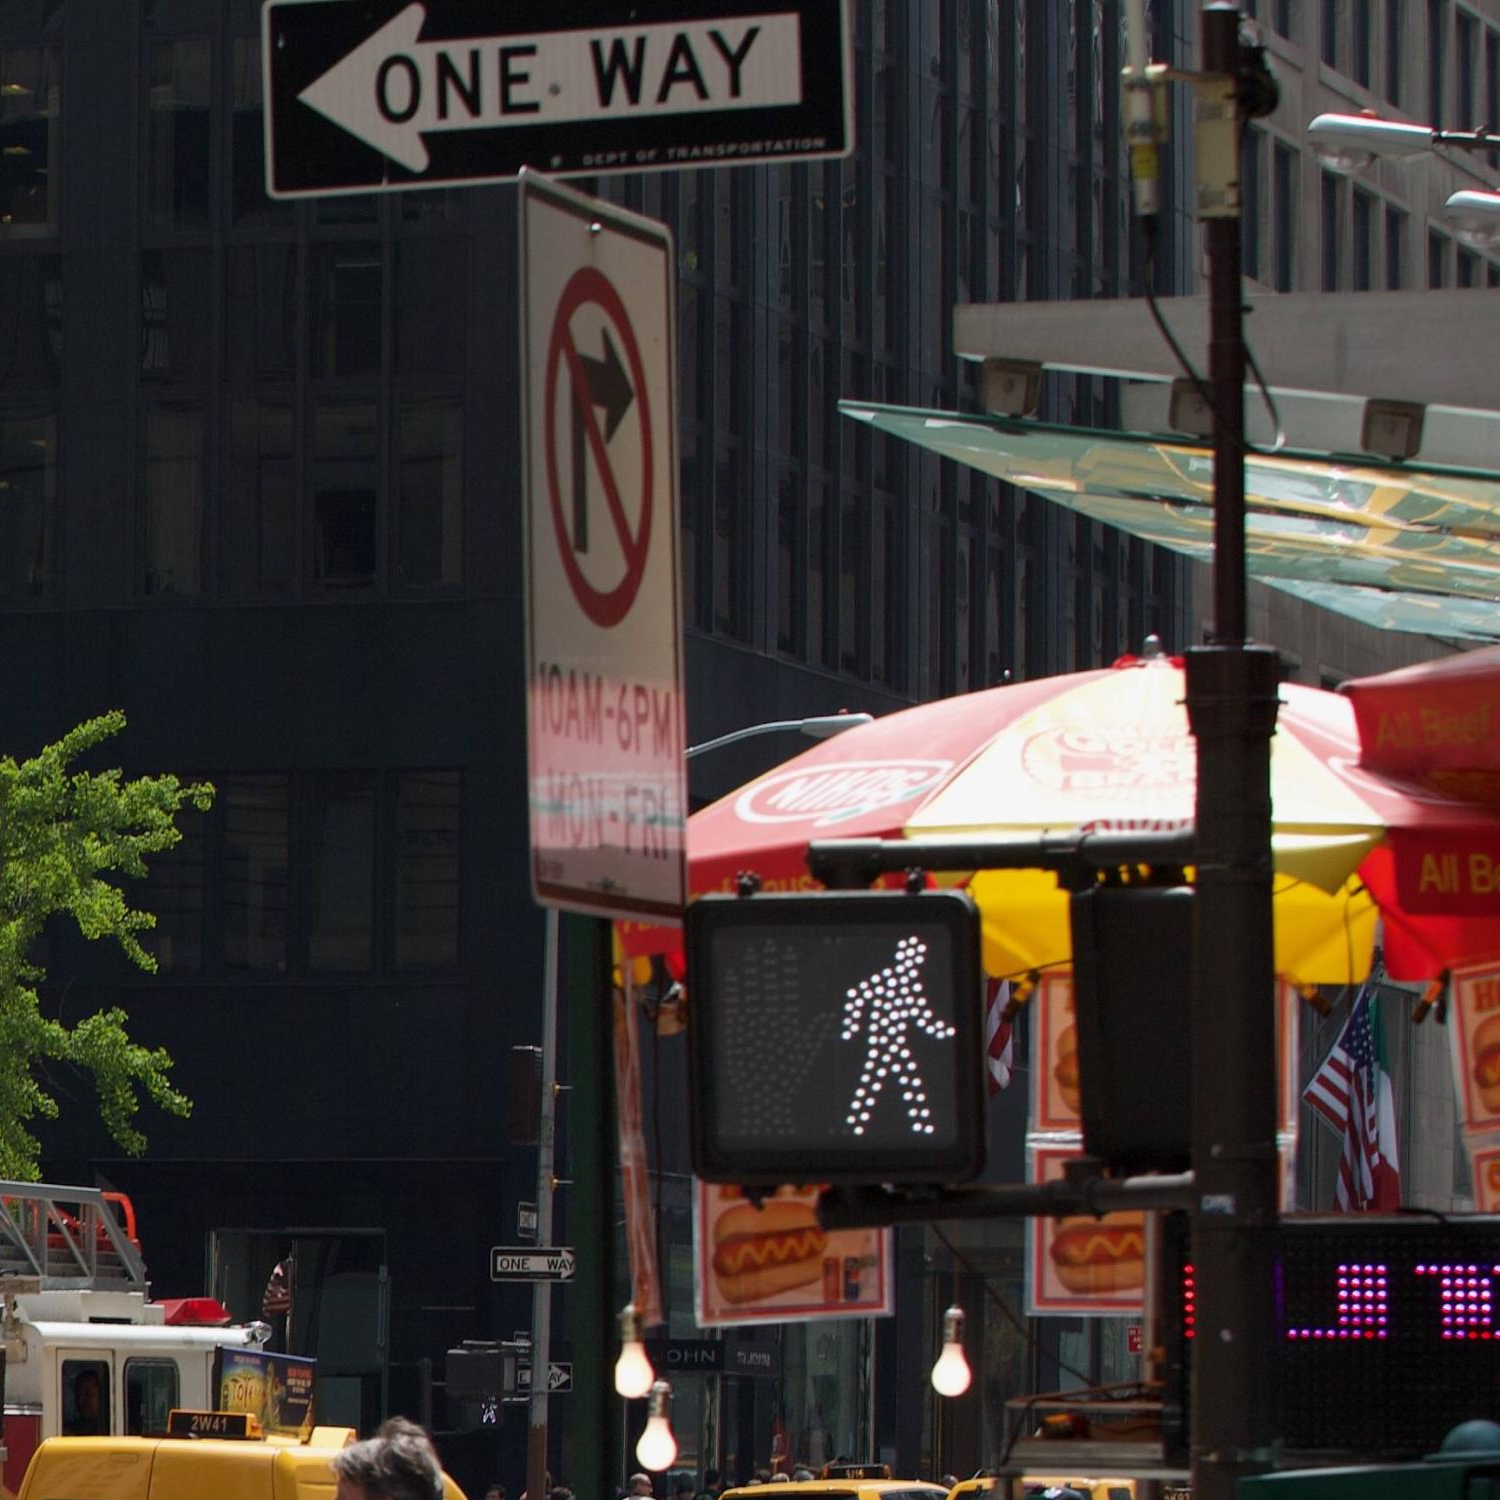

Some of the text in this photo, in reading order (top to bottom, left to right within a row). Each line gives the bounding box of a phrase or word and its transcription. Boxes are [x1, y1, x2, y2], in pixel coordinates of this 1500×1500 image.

[375, 26, 761, 124] ONE WAY
[582, 136, 827, 167] DEPT OF TRANSPORTATION
[1419, 852, 1461, 895] All
[500, 1258, 575, 1271] ONE WAY
[191, 1415, 228, 1433] 2W41
